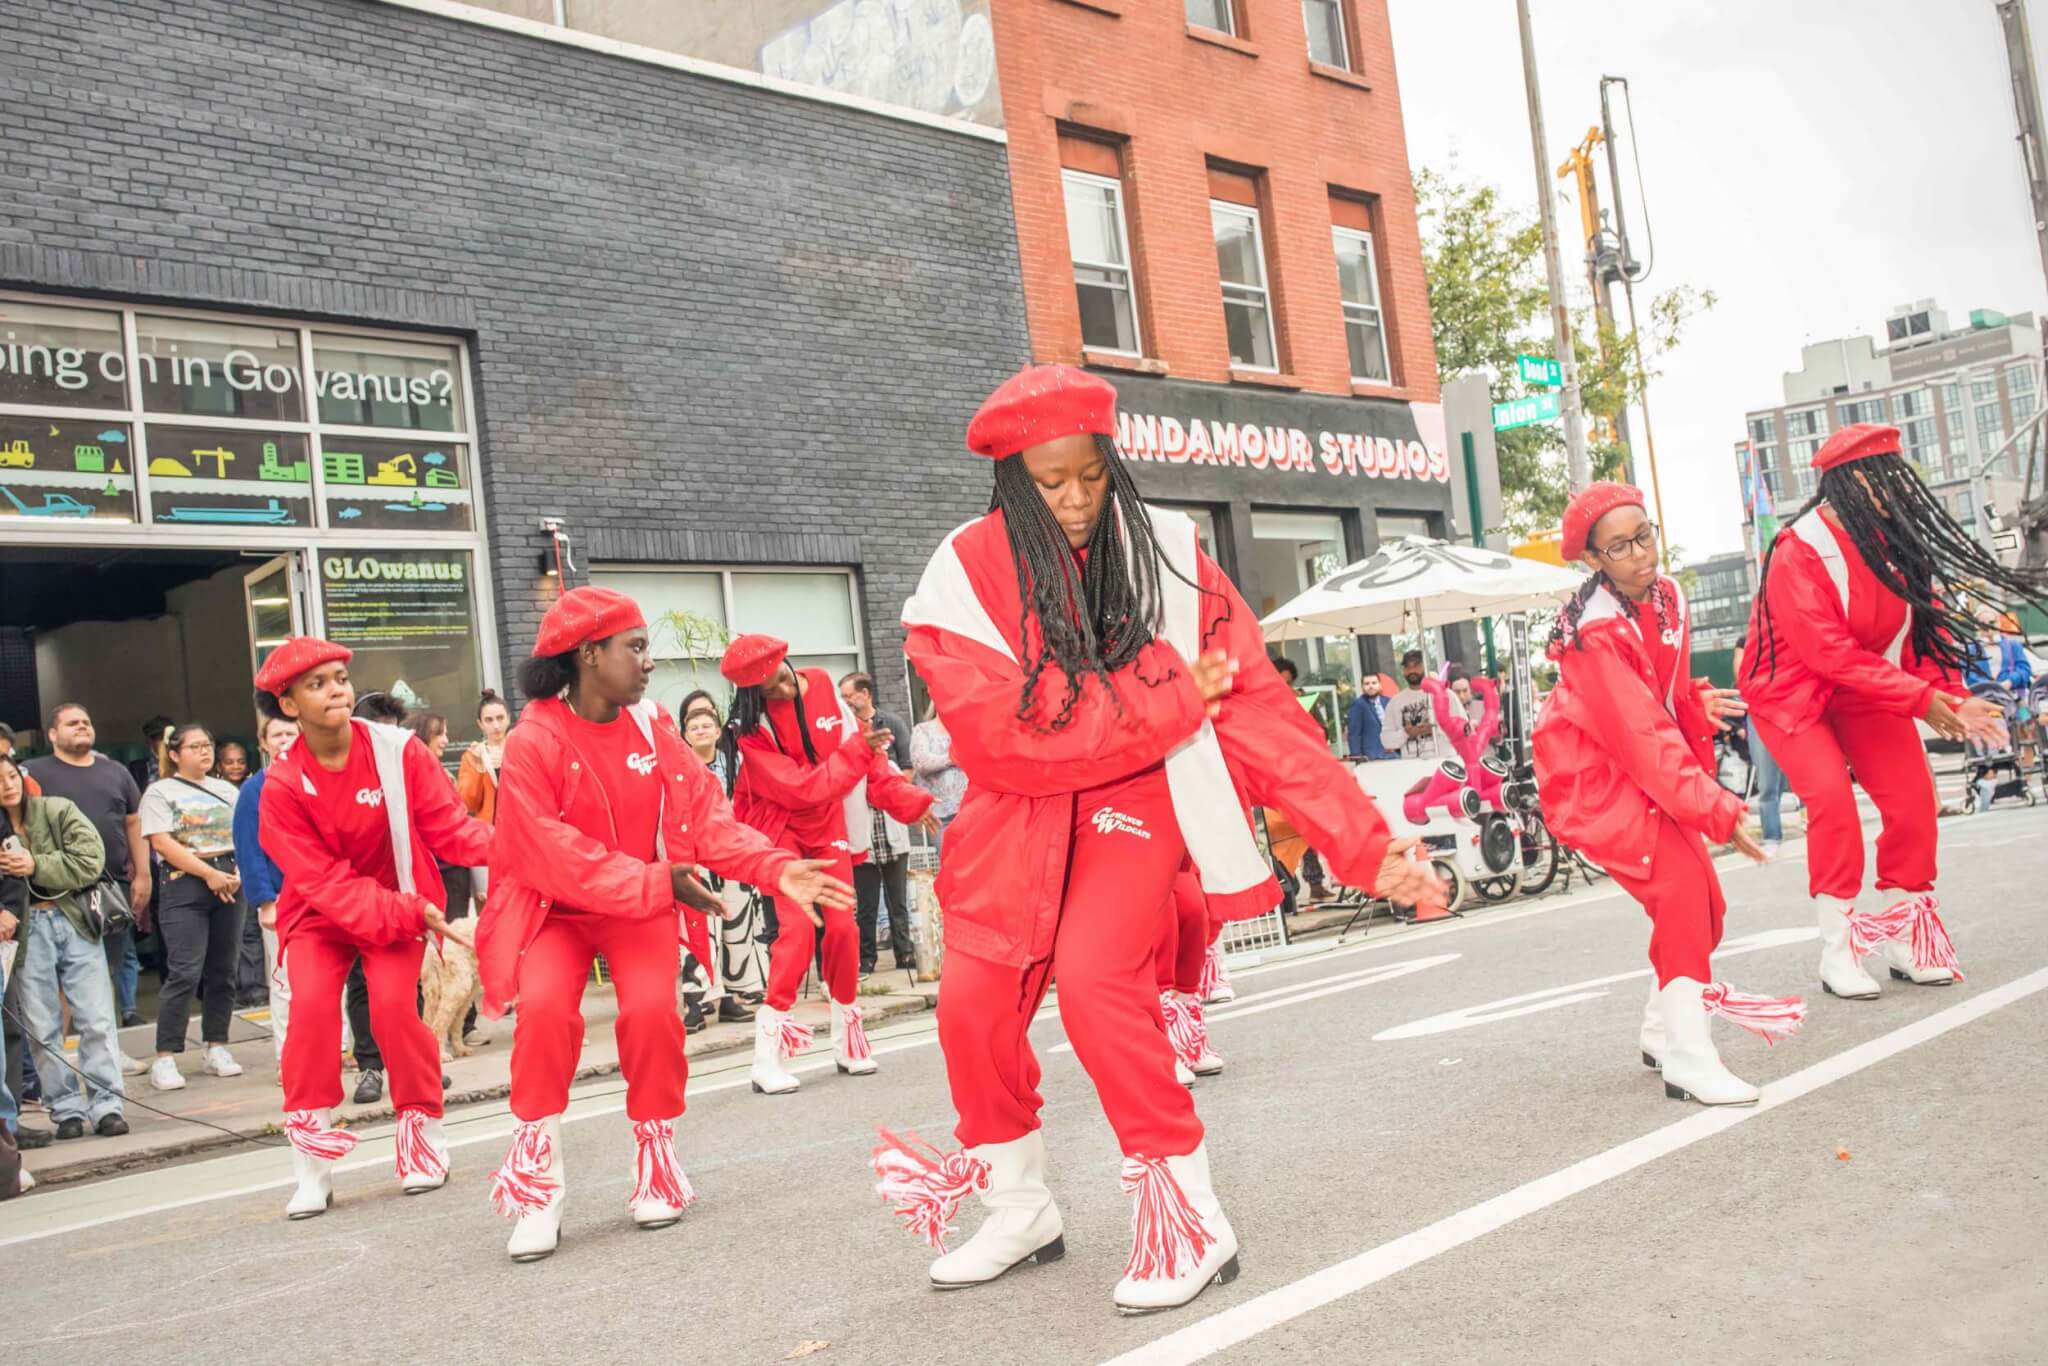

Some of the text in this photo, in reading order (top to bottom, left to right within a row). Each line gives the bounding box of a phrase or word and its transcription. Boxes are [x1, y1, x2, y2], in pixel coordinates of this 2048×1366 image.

[0, 331, 453, 406] ing on in Gowanus?
[1497, 402, 1537, 427] nion
[1318, 431, 1450, 483] STUDIOS
[323, 557, 463, 580] GLOwanus
